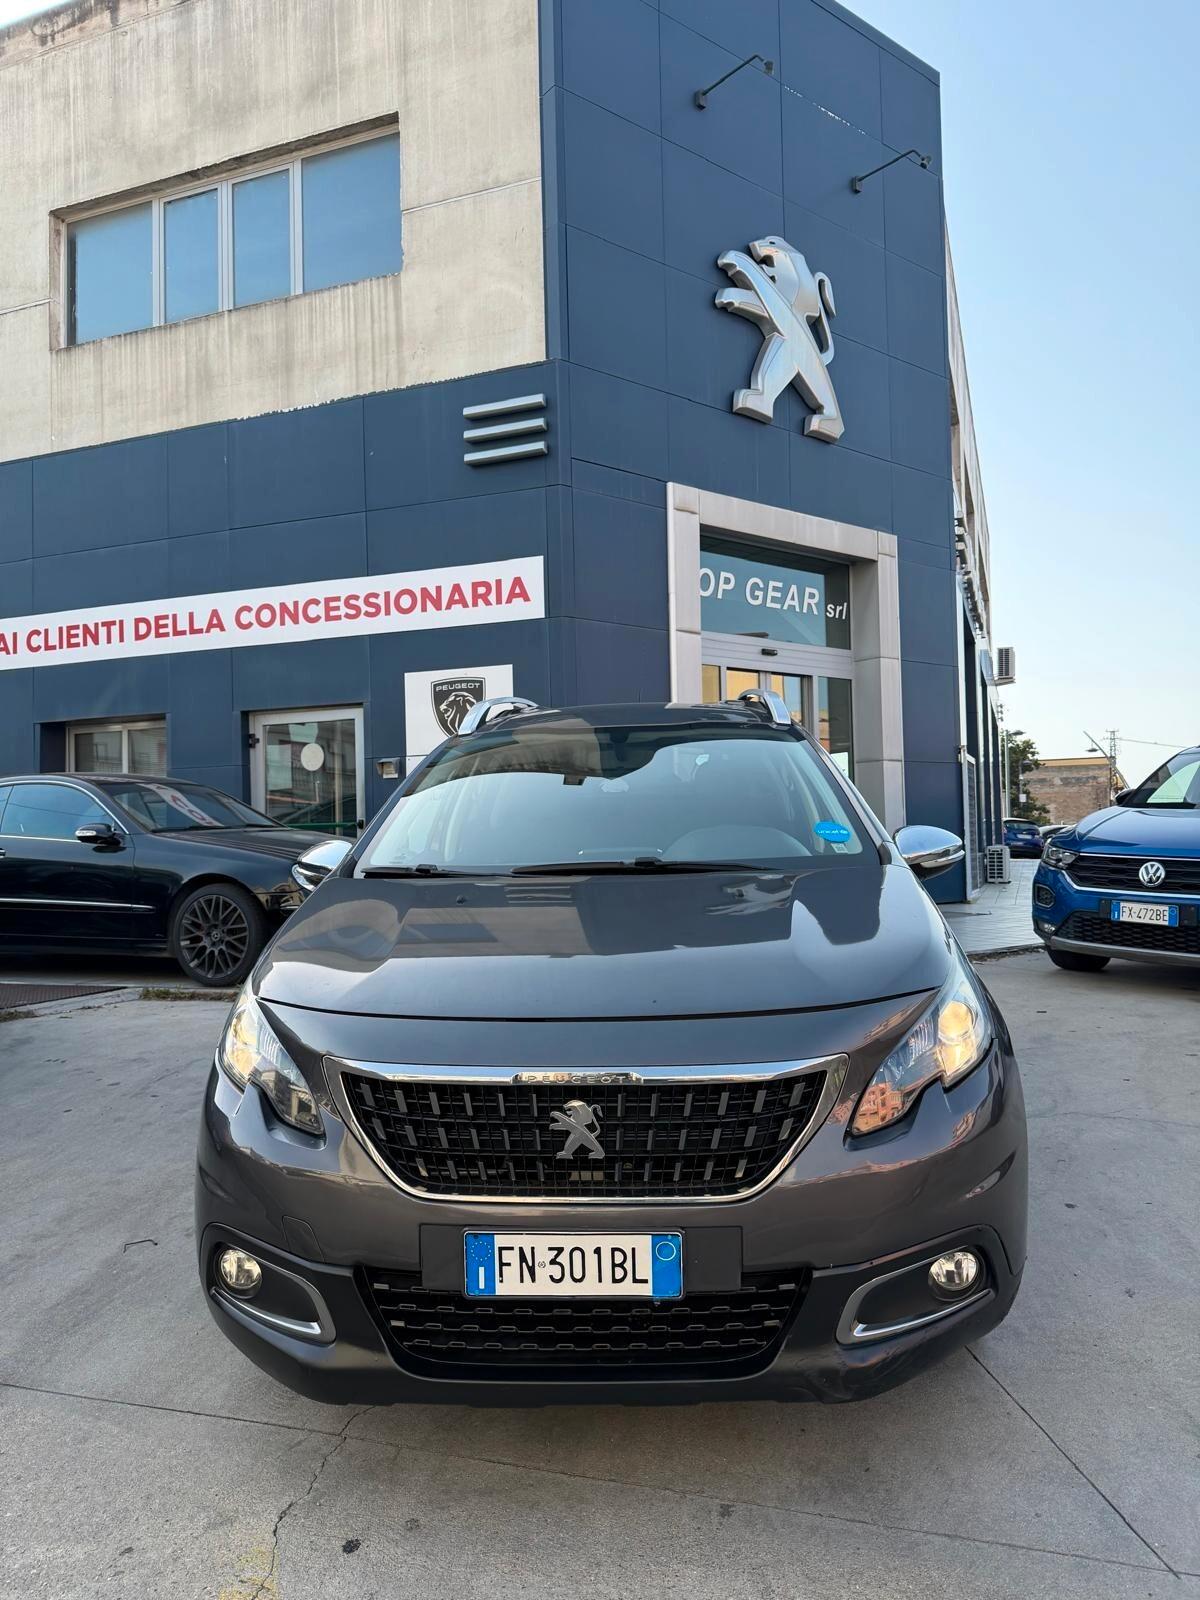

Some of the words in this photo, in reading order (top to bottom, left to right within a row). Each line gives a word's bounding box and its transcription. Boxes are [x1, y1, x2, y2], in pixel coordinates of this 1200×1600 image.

[745, 577, 820, 615] GEAR
[826, 601, 848, 620] srl
[26, 619, 125, 653] CLIENTI
[134, 608, 226, 642] DELLA
[234, 576, 531, 631] CONCESSIONARIA
[435, 683, 480, 691] PEUGEOT
[527, 1075, 627, 1084] PEUGEOT
